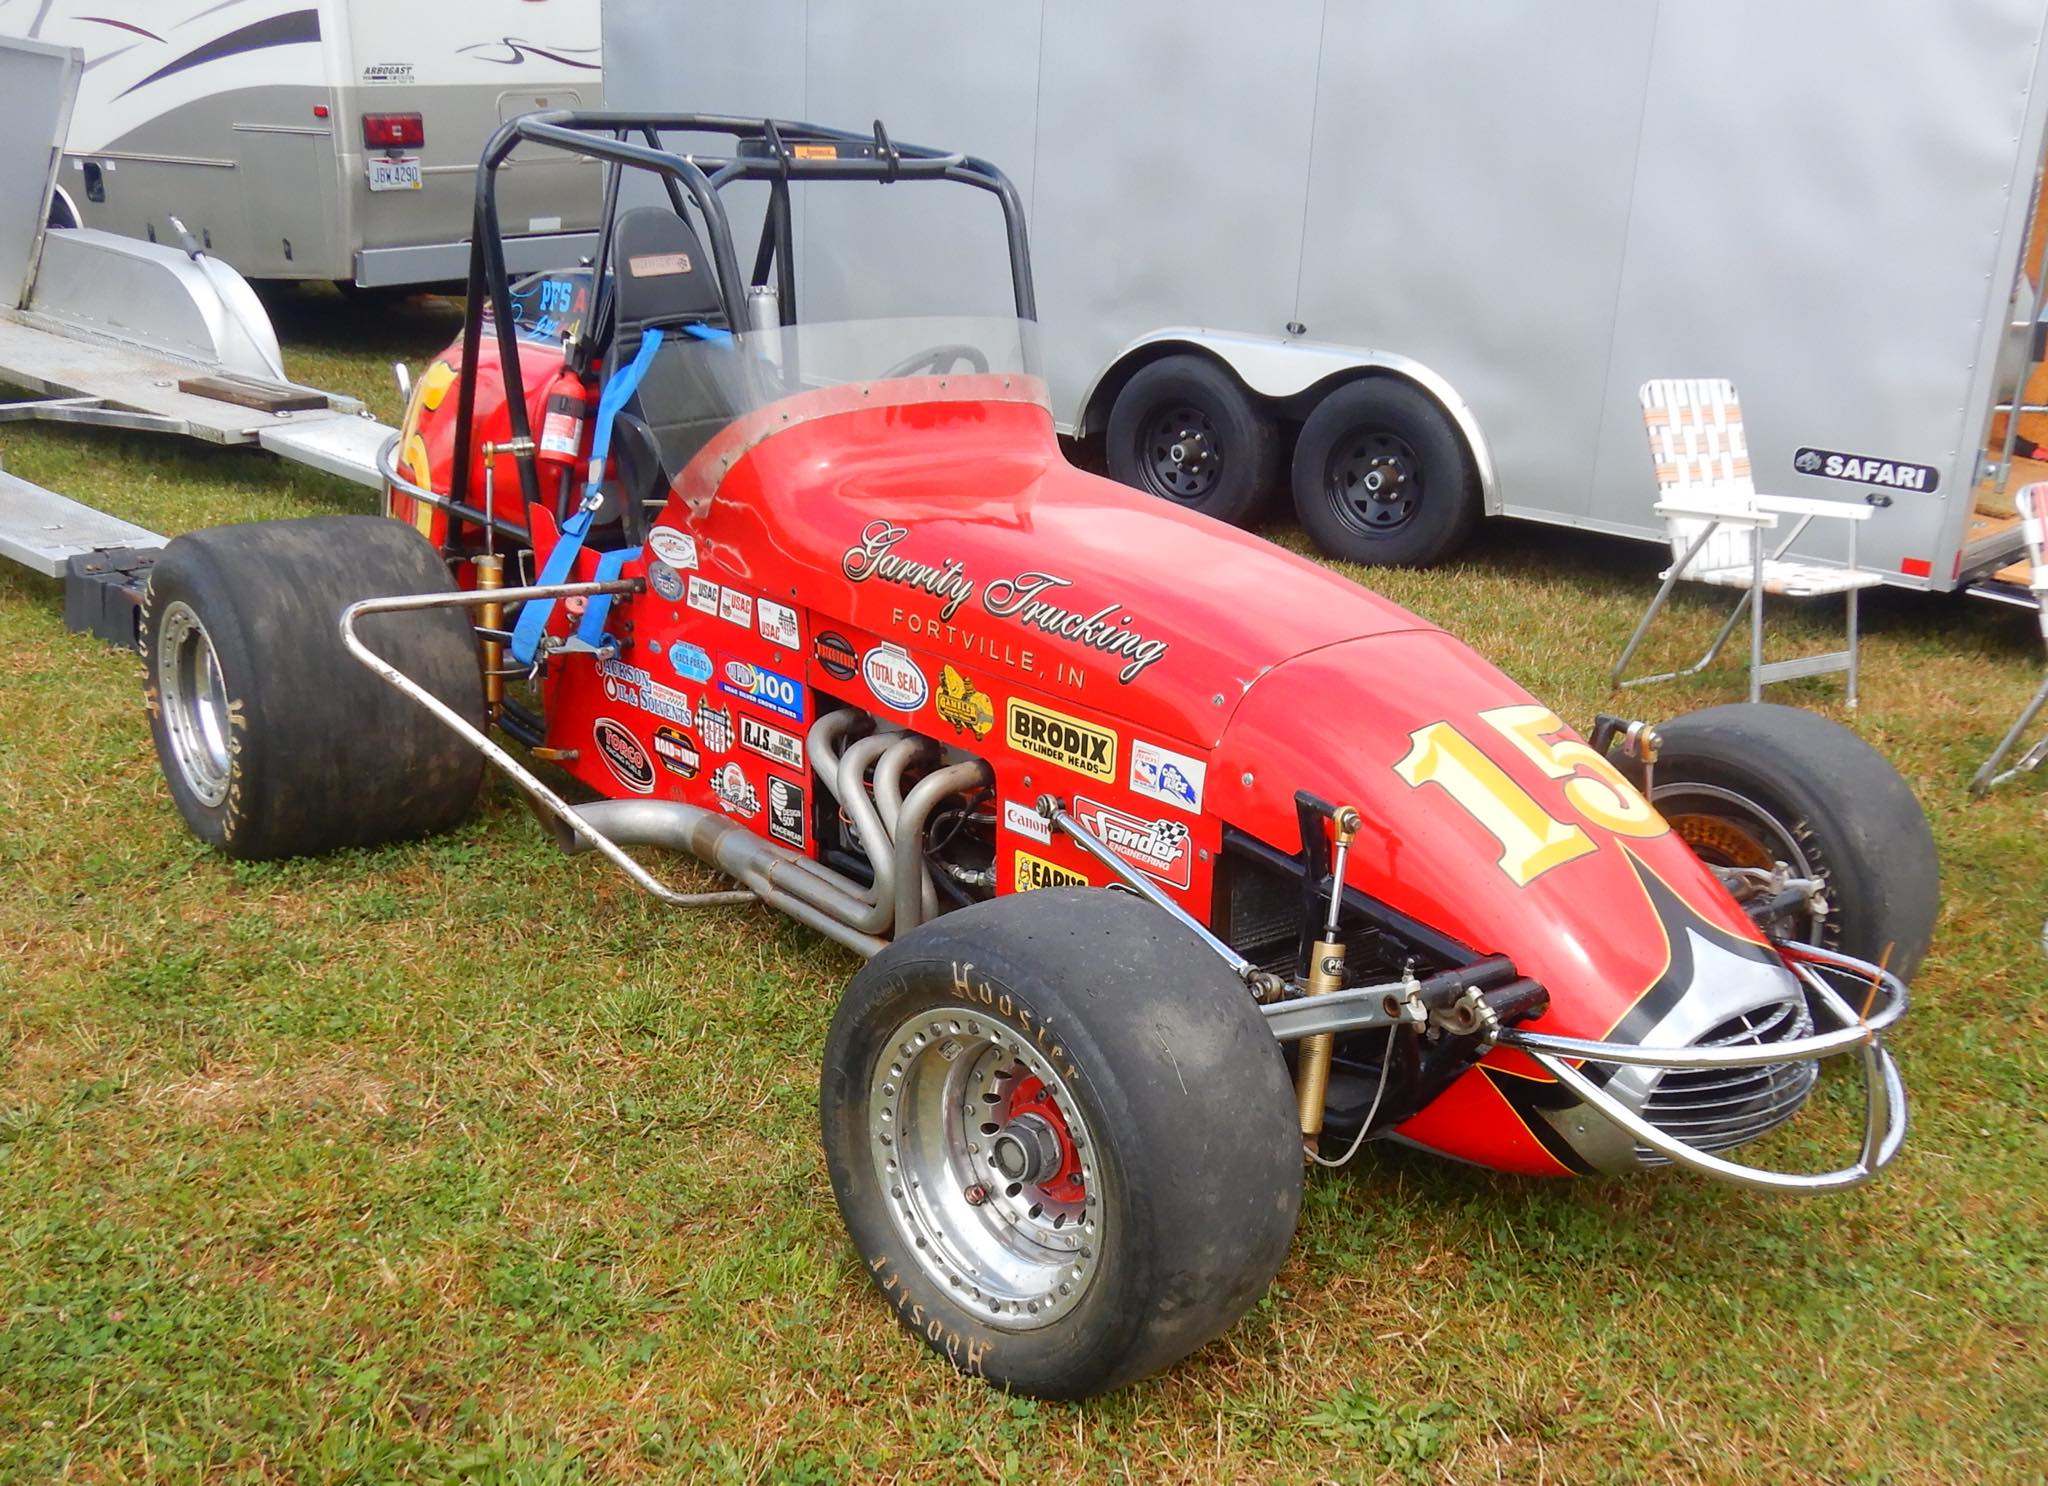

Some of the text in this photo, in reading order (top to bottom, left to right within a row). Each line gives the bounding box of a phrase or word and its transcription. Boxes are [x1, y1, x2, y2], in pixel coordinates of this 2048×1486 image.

[364, 66, 413, 75] ARBOGAST
[394, 166, 418, 182] 4290
[1825, 455, 1927, 489] SAFARI
[698, 582, 717, 602] USAC
[731, 593, 751, 615] USAC
[842, 519, 1168, 684] Garrity Trucking
[761, 621, 781, 641] USAC
[892, 608, 1046, 680] FORTVILLE,
[1057, 663, 1086, 690] IN
[594, 658, 652, 693] JACKSON
[756, 671, 795, 705] 100
[870, 660, 920, 697] TOTAL SEAL
[640, 688, 692, 727] SOLVENTS
[604, 727, 644, 769] TORCO
[1014, 710, 1109, 765] BRODIX
[1022, 738, 1101, 775] CYLINDER HEADS
[782, 808, 802, 818] DESIGN
[1392, 704, 1672, 888] 15
[772, 822, 803, 843] RACEWEAR
[782, 816, 795, 828] 500
[1007, 810, 1051, 838] Canon
[1079, 810, 1184, 865] Sander
[1108, 842, 1171, 872] ENGINEERING
